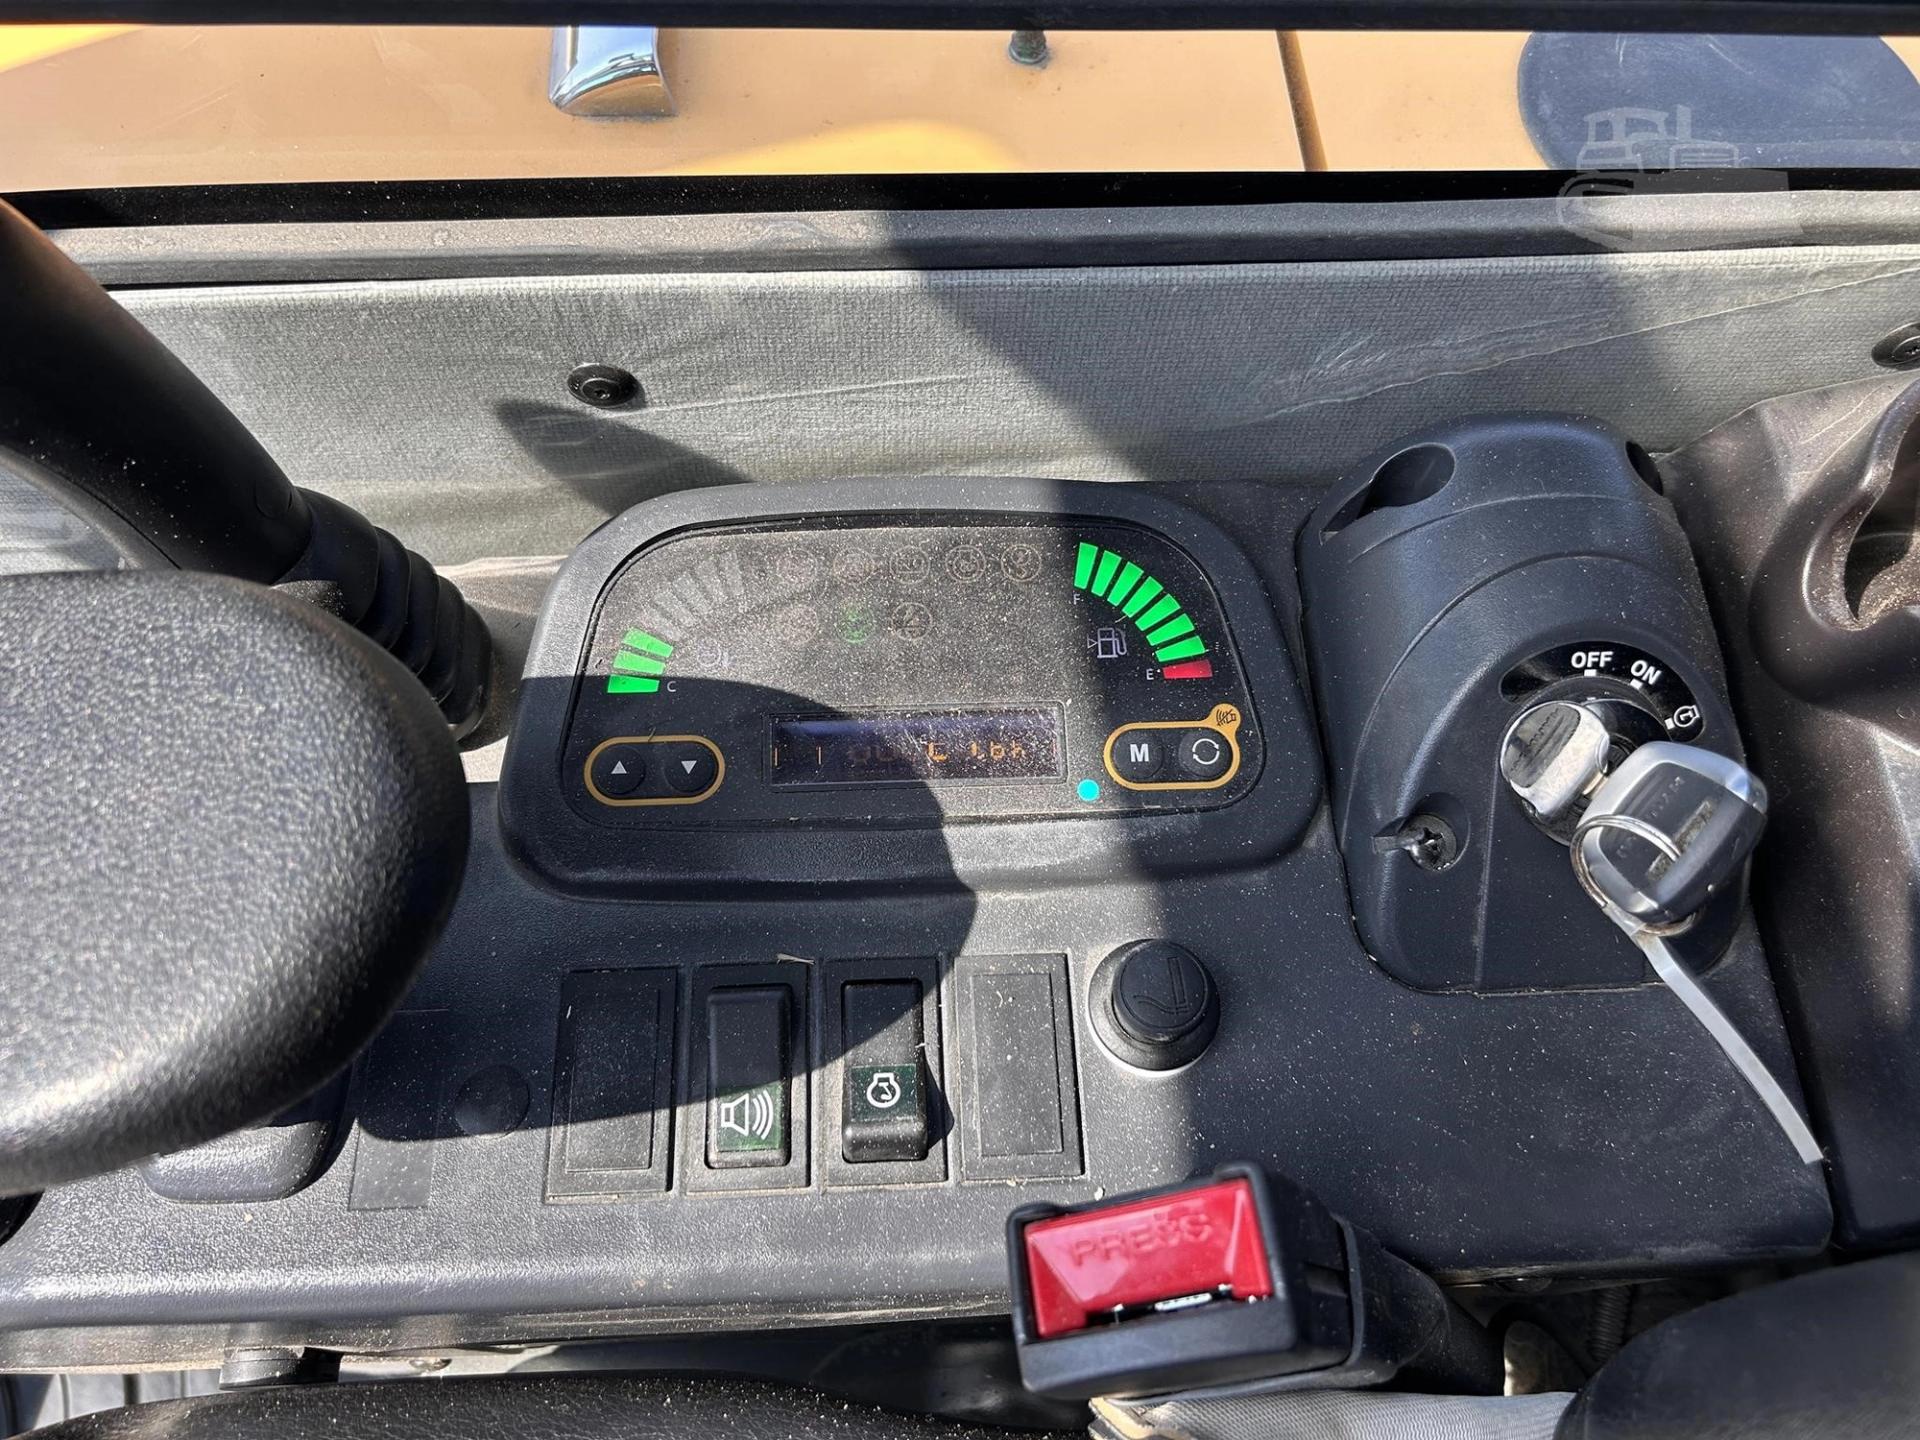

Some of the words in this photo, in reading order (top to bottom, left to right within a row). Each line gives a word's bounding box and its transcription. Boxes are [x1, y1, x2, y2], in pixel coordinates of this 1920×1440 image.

[1073, 593, 1081, 605] F
[1571, 651, 1613, 668] OFF
[1146, 669, 1154, 681] E
[1630, 660, 1662, 685] ON
[667, 681, 677, 693] C
[1130, 744, 1150, 763] M
